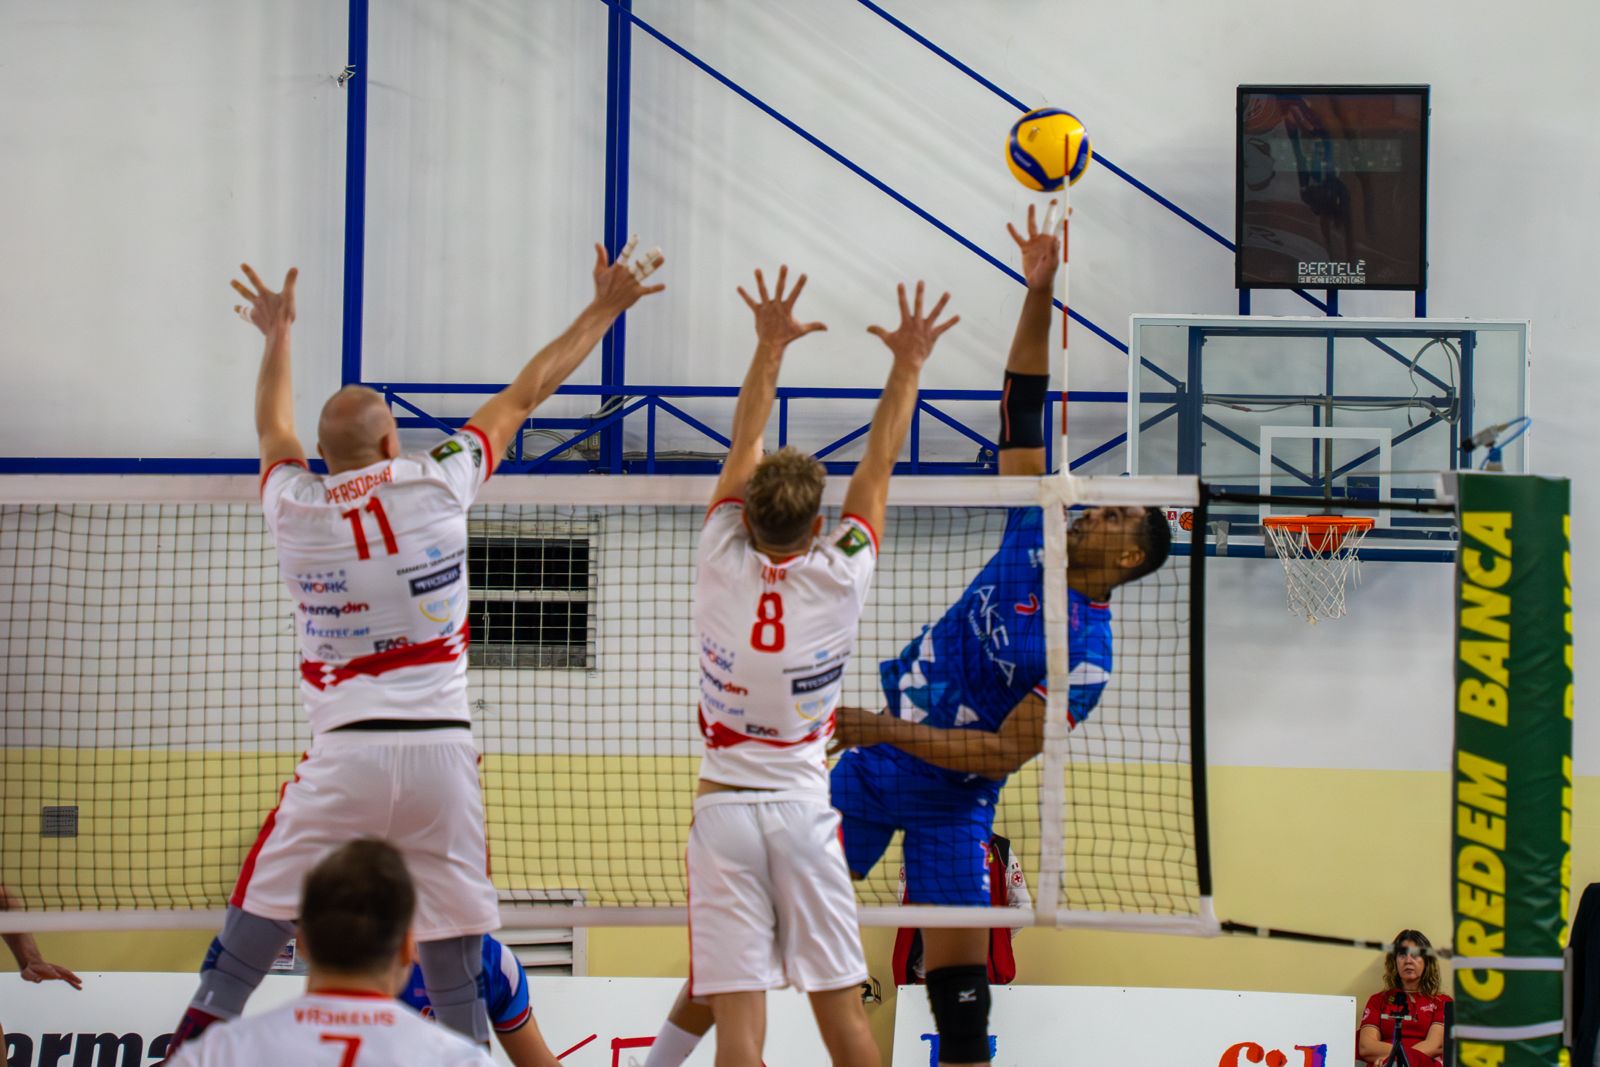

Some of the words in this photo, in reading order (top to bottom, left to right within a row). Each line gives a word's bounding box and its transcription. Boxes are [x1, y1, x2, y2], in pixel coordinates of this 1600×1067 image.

[1298, 276, 1366, 284] ELECTRONICS
[341, 496, 399, 561] 11
[750, 591, 785, 653] 8
[1458, 511, 1514, 727] BANCA
[1455, 750, 1508, 1003] CREDEM
